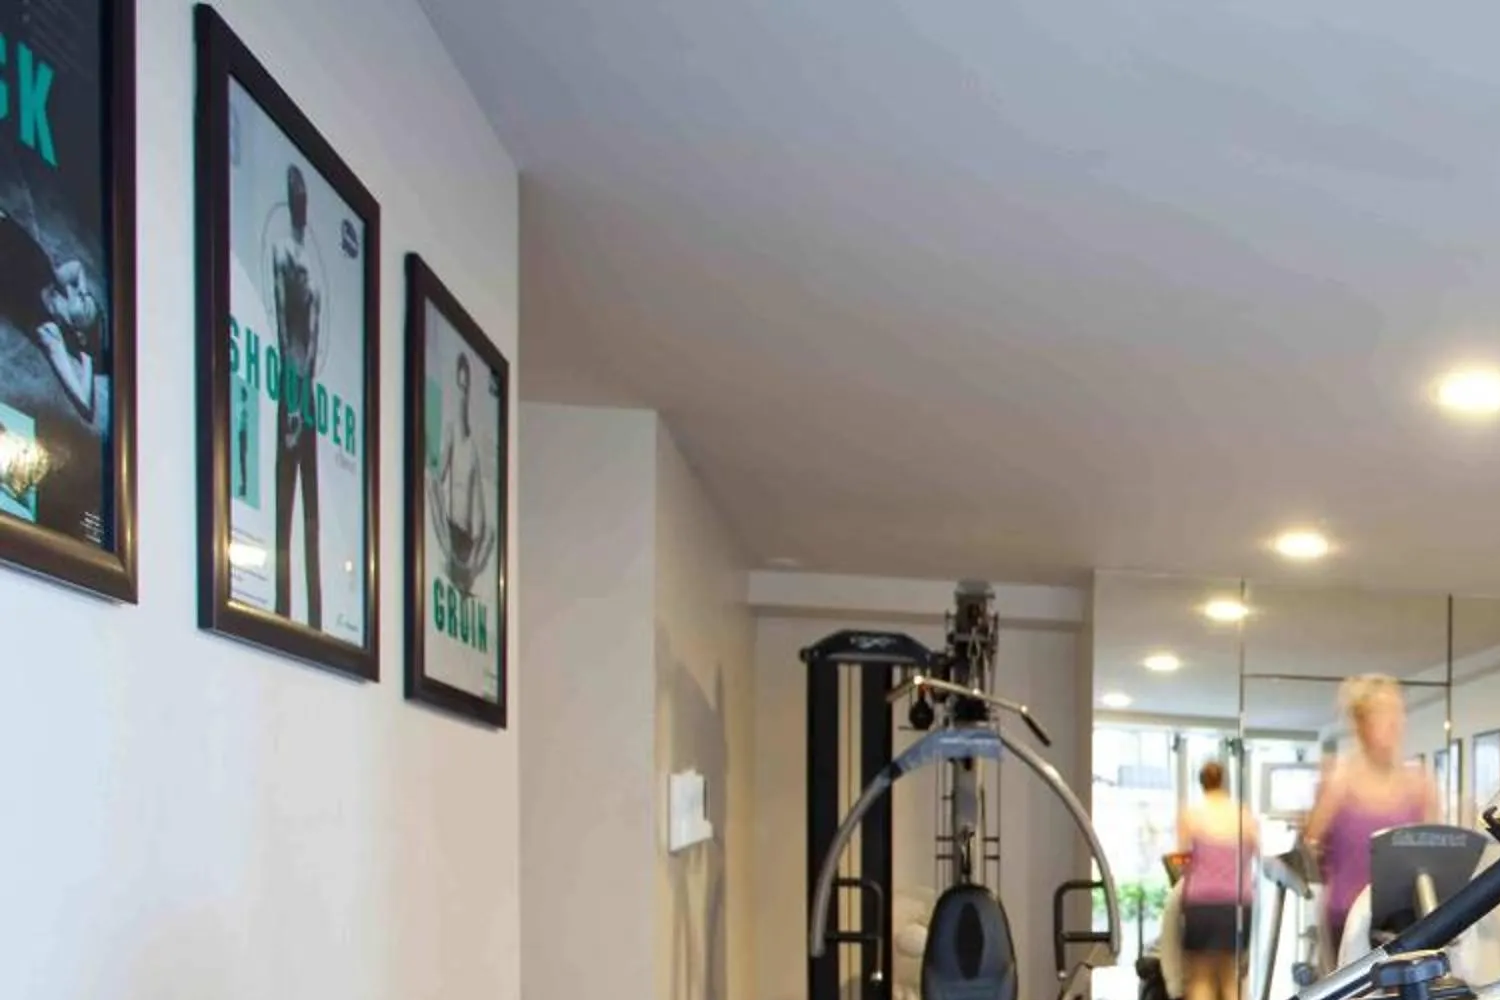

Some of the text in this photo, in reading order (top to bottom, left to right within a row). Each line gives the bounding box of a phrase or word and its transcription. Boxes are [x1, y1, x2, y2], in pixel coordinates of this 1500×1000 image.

[0, 31, 59, 172] K
[229, 313, 357, 456] SHOULDER
[433, 577, 488, 654] GROIN
